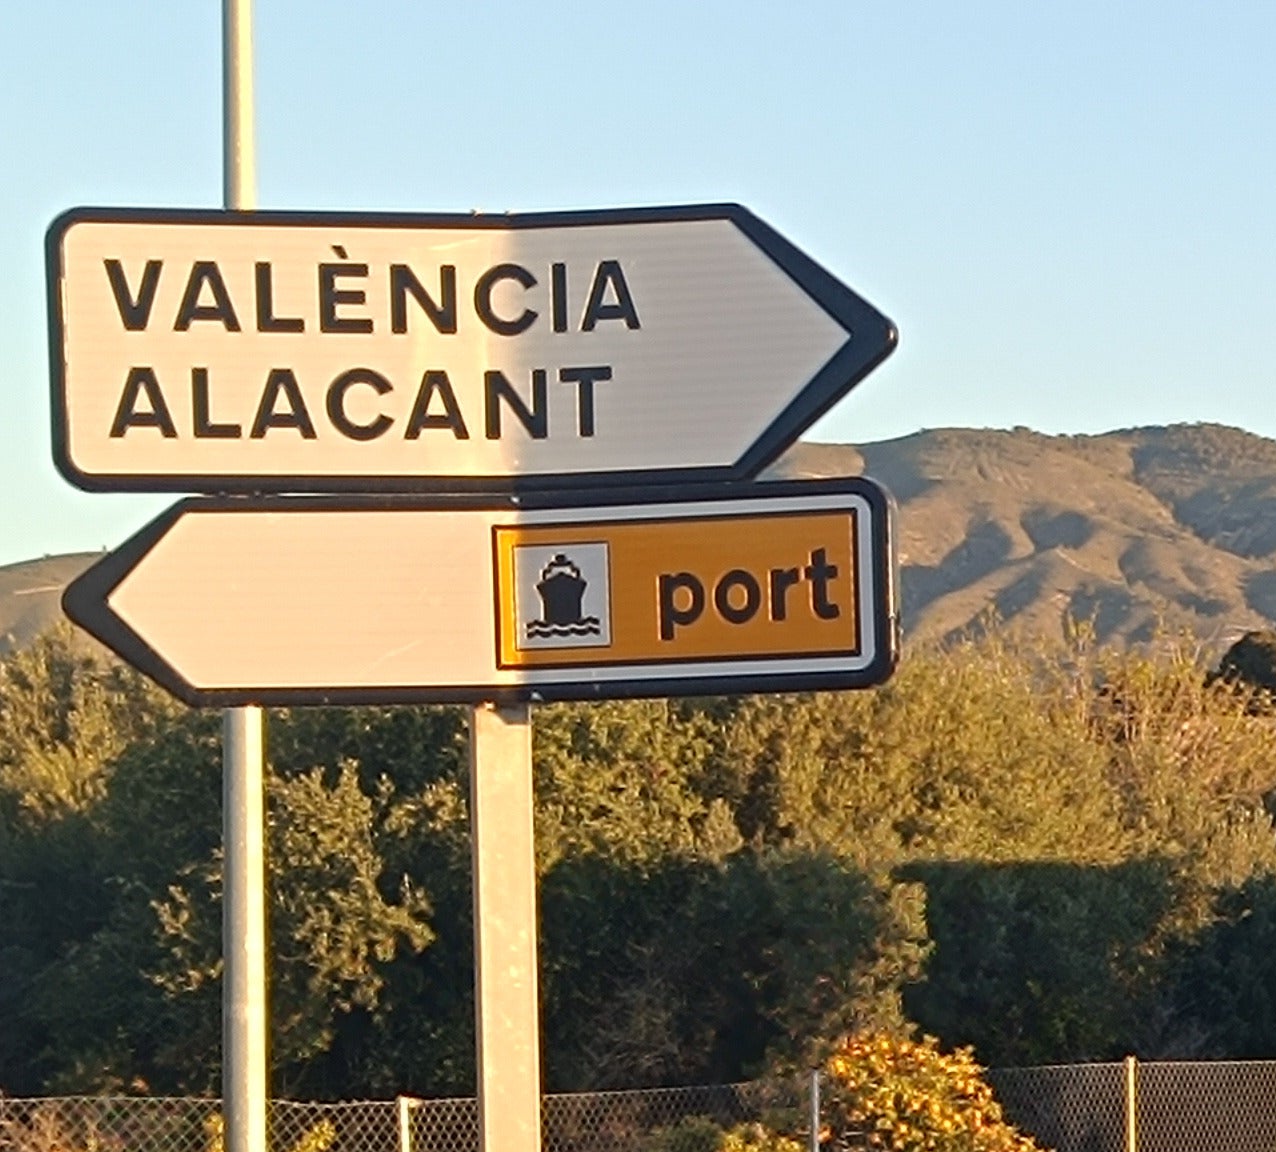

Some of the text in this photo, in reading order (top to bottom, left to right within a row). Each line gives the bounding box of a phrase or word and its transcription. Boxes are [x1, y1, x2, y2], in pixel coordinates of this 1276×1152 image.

[103, 246, 642, 336] VALÈNCIA
[108, 366, 613, 441] ALACANT
[656, 547, 842, 641] port
